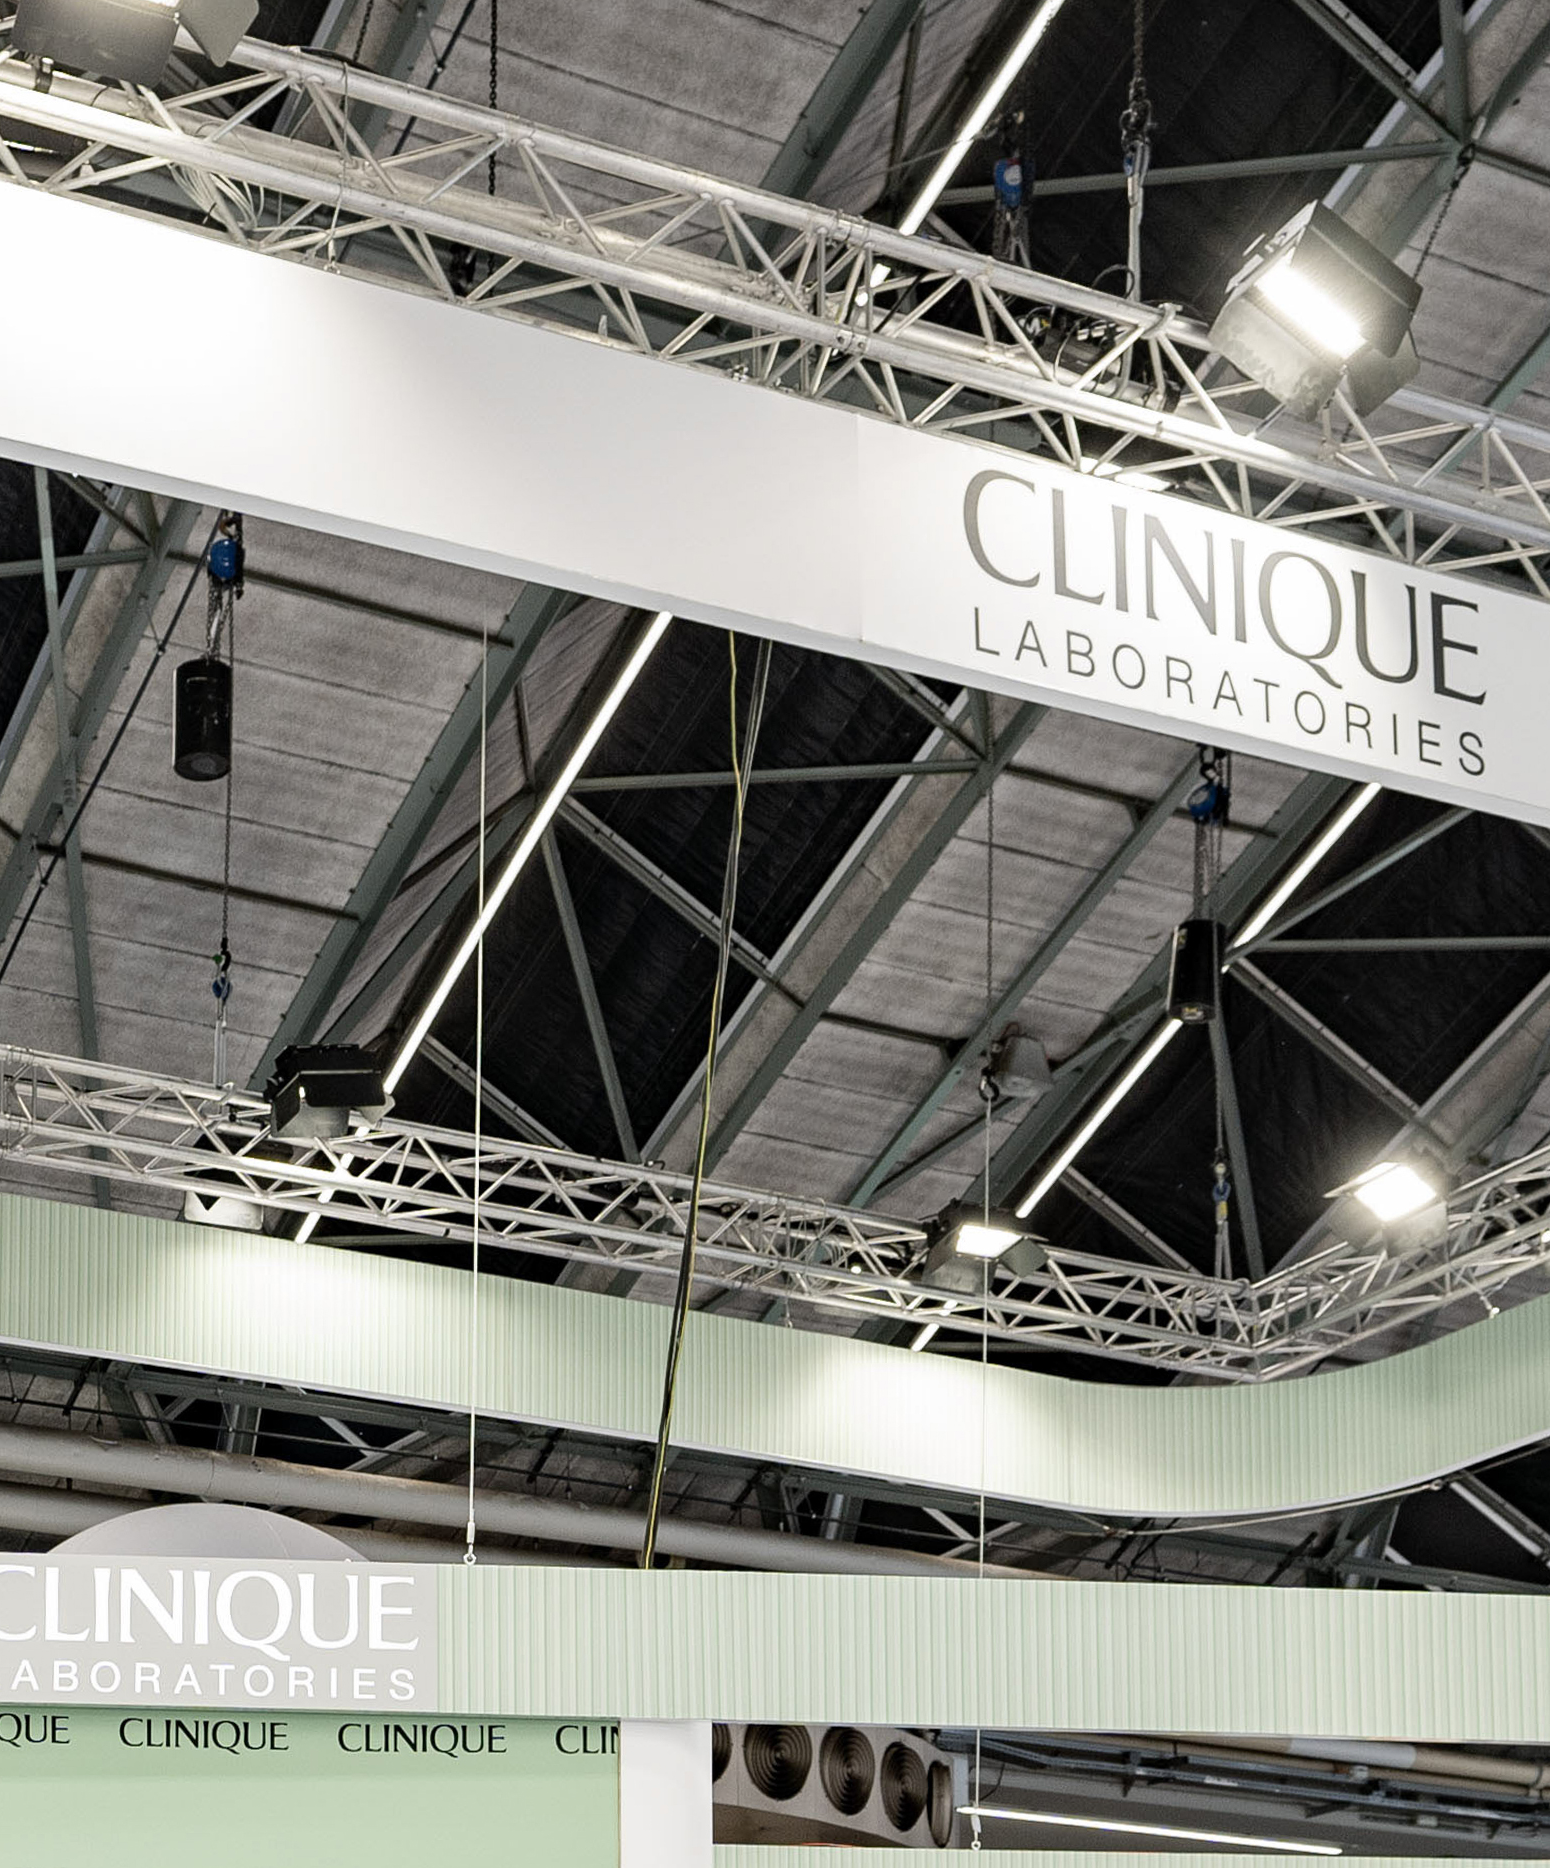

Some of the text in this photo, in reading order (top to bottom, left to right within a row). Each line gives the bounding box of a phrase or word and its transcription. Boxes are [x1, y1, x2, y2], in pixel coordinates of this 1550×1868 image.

[963, 469, 1487, 706] CLINIQUE
[973, 606, 1487, 778] LABORATORIES
[119, 1717, 289, 1755] CLINIQUE
[337, 1723, 507, 1758] CLINIQUE
